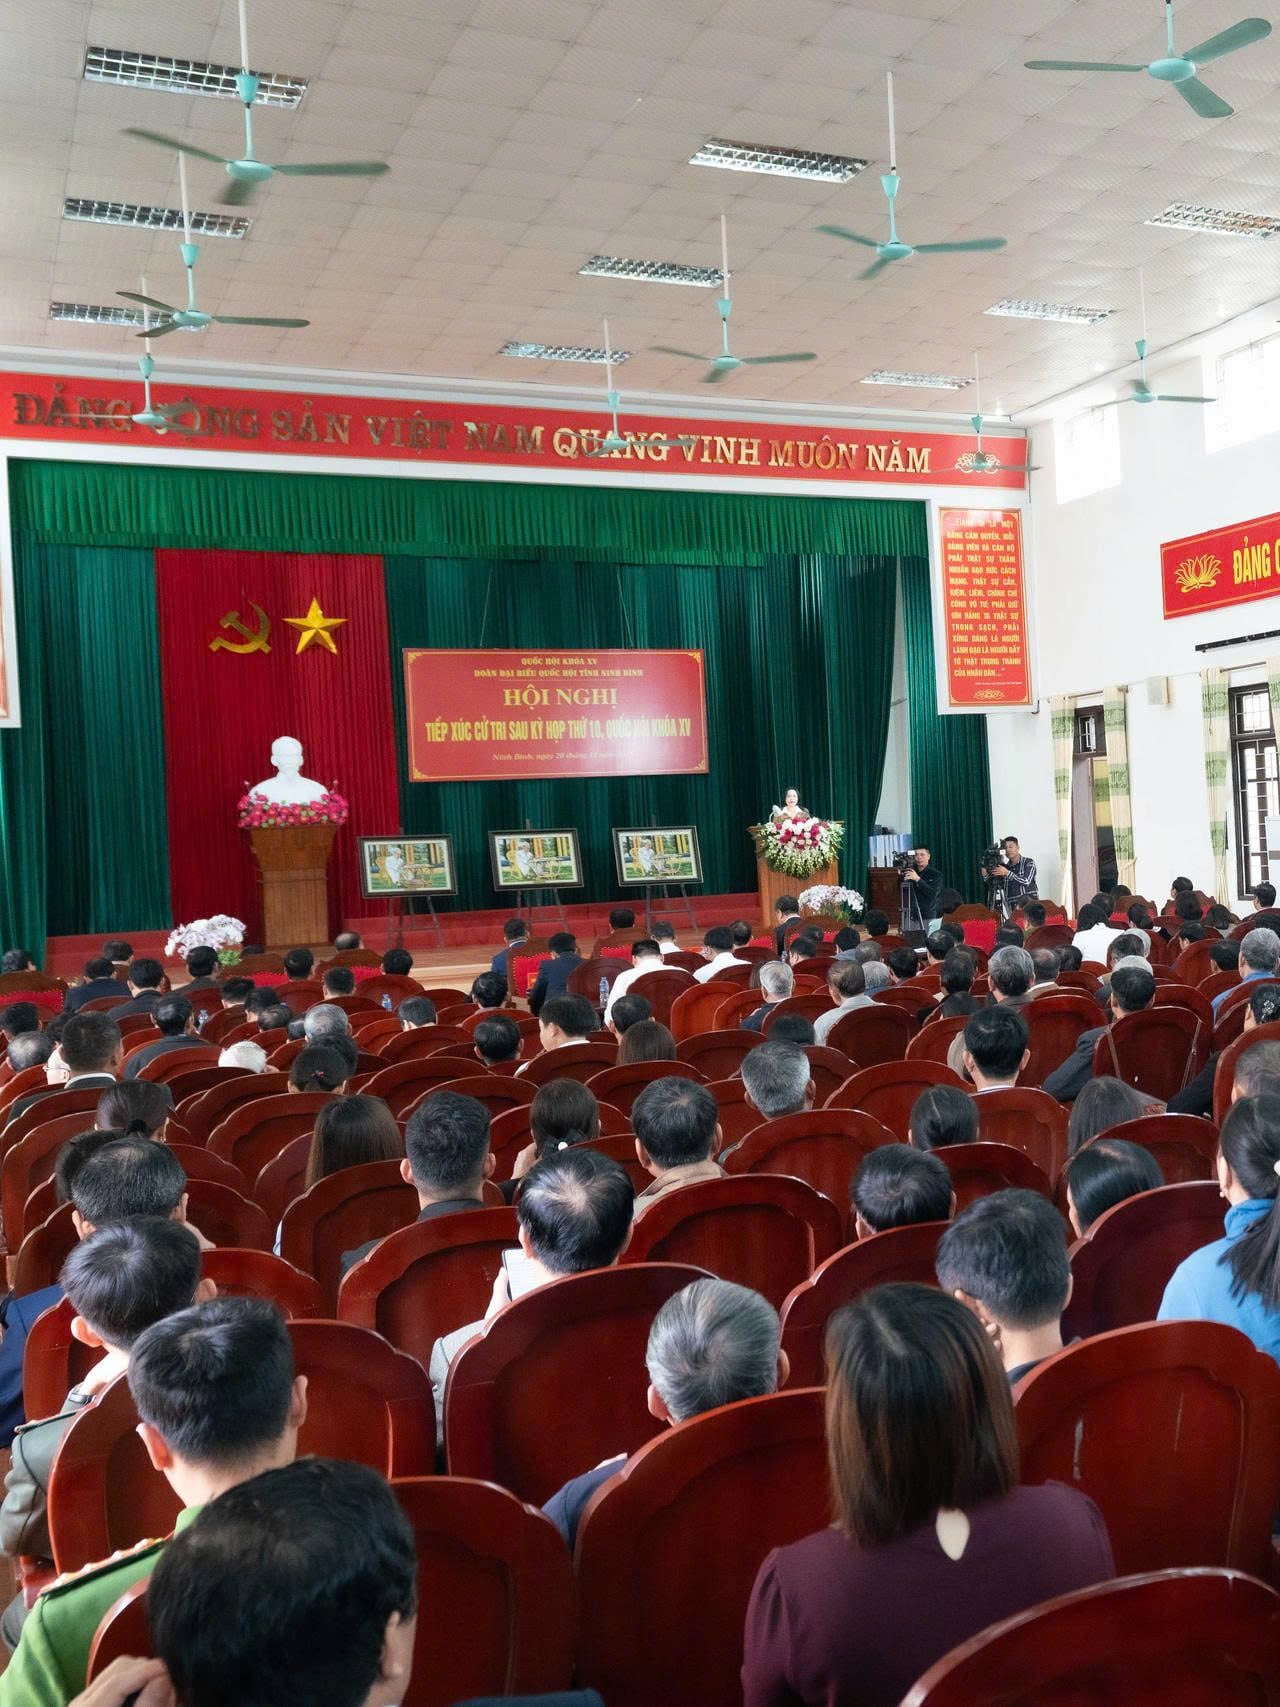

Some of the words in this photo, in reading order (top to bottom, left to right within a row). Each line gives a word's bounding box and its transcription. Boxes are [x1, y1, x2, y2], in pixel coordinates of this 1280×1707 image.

[13, 383, 132, 433] ĐẢNG
[271, 400, 351, 445] SẢN
[366, 410, 452, 454] VIỆT
[464, 421, 544, 457] NAM
[553, 427, 670, 463] QUANG
[677, 433, 761, 466] VINH
[768, 434, 859, 471] MUÔN
[865, 441, 931, 474] NĂM
[1233, 535, 1271, 584] ĐẢNG
[521, 656, 543, 666] QUỐC
[546, 656, 560, 666] HỘI
[587, 657, 598, 665] XV
[539, 668, 560, 677] QUỐC
[503, 683, 550, 710] HỘI
[556, 687, 618, 709] NGHỊ
[425, 715, 448, 742] TIẾP
[450, 717, 472, 741] XÚC
[474, 715, 489, 741] CỬ
[490, 722, 506, 740] TRI
[509, 721, 529, 740] SAU
[530, 716, 544, 740] KỲ
[546, 721, 566, 743] HỌP
[567, 716, 588, 739] THỨ
[678, 718, 691, 737] XV
